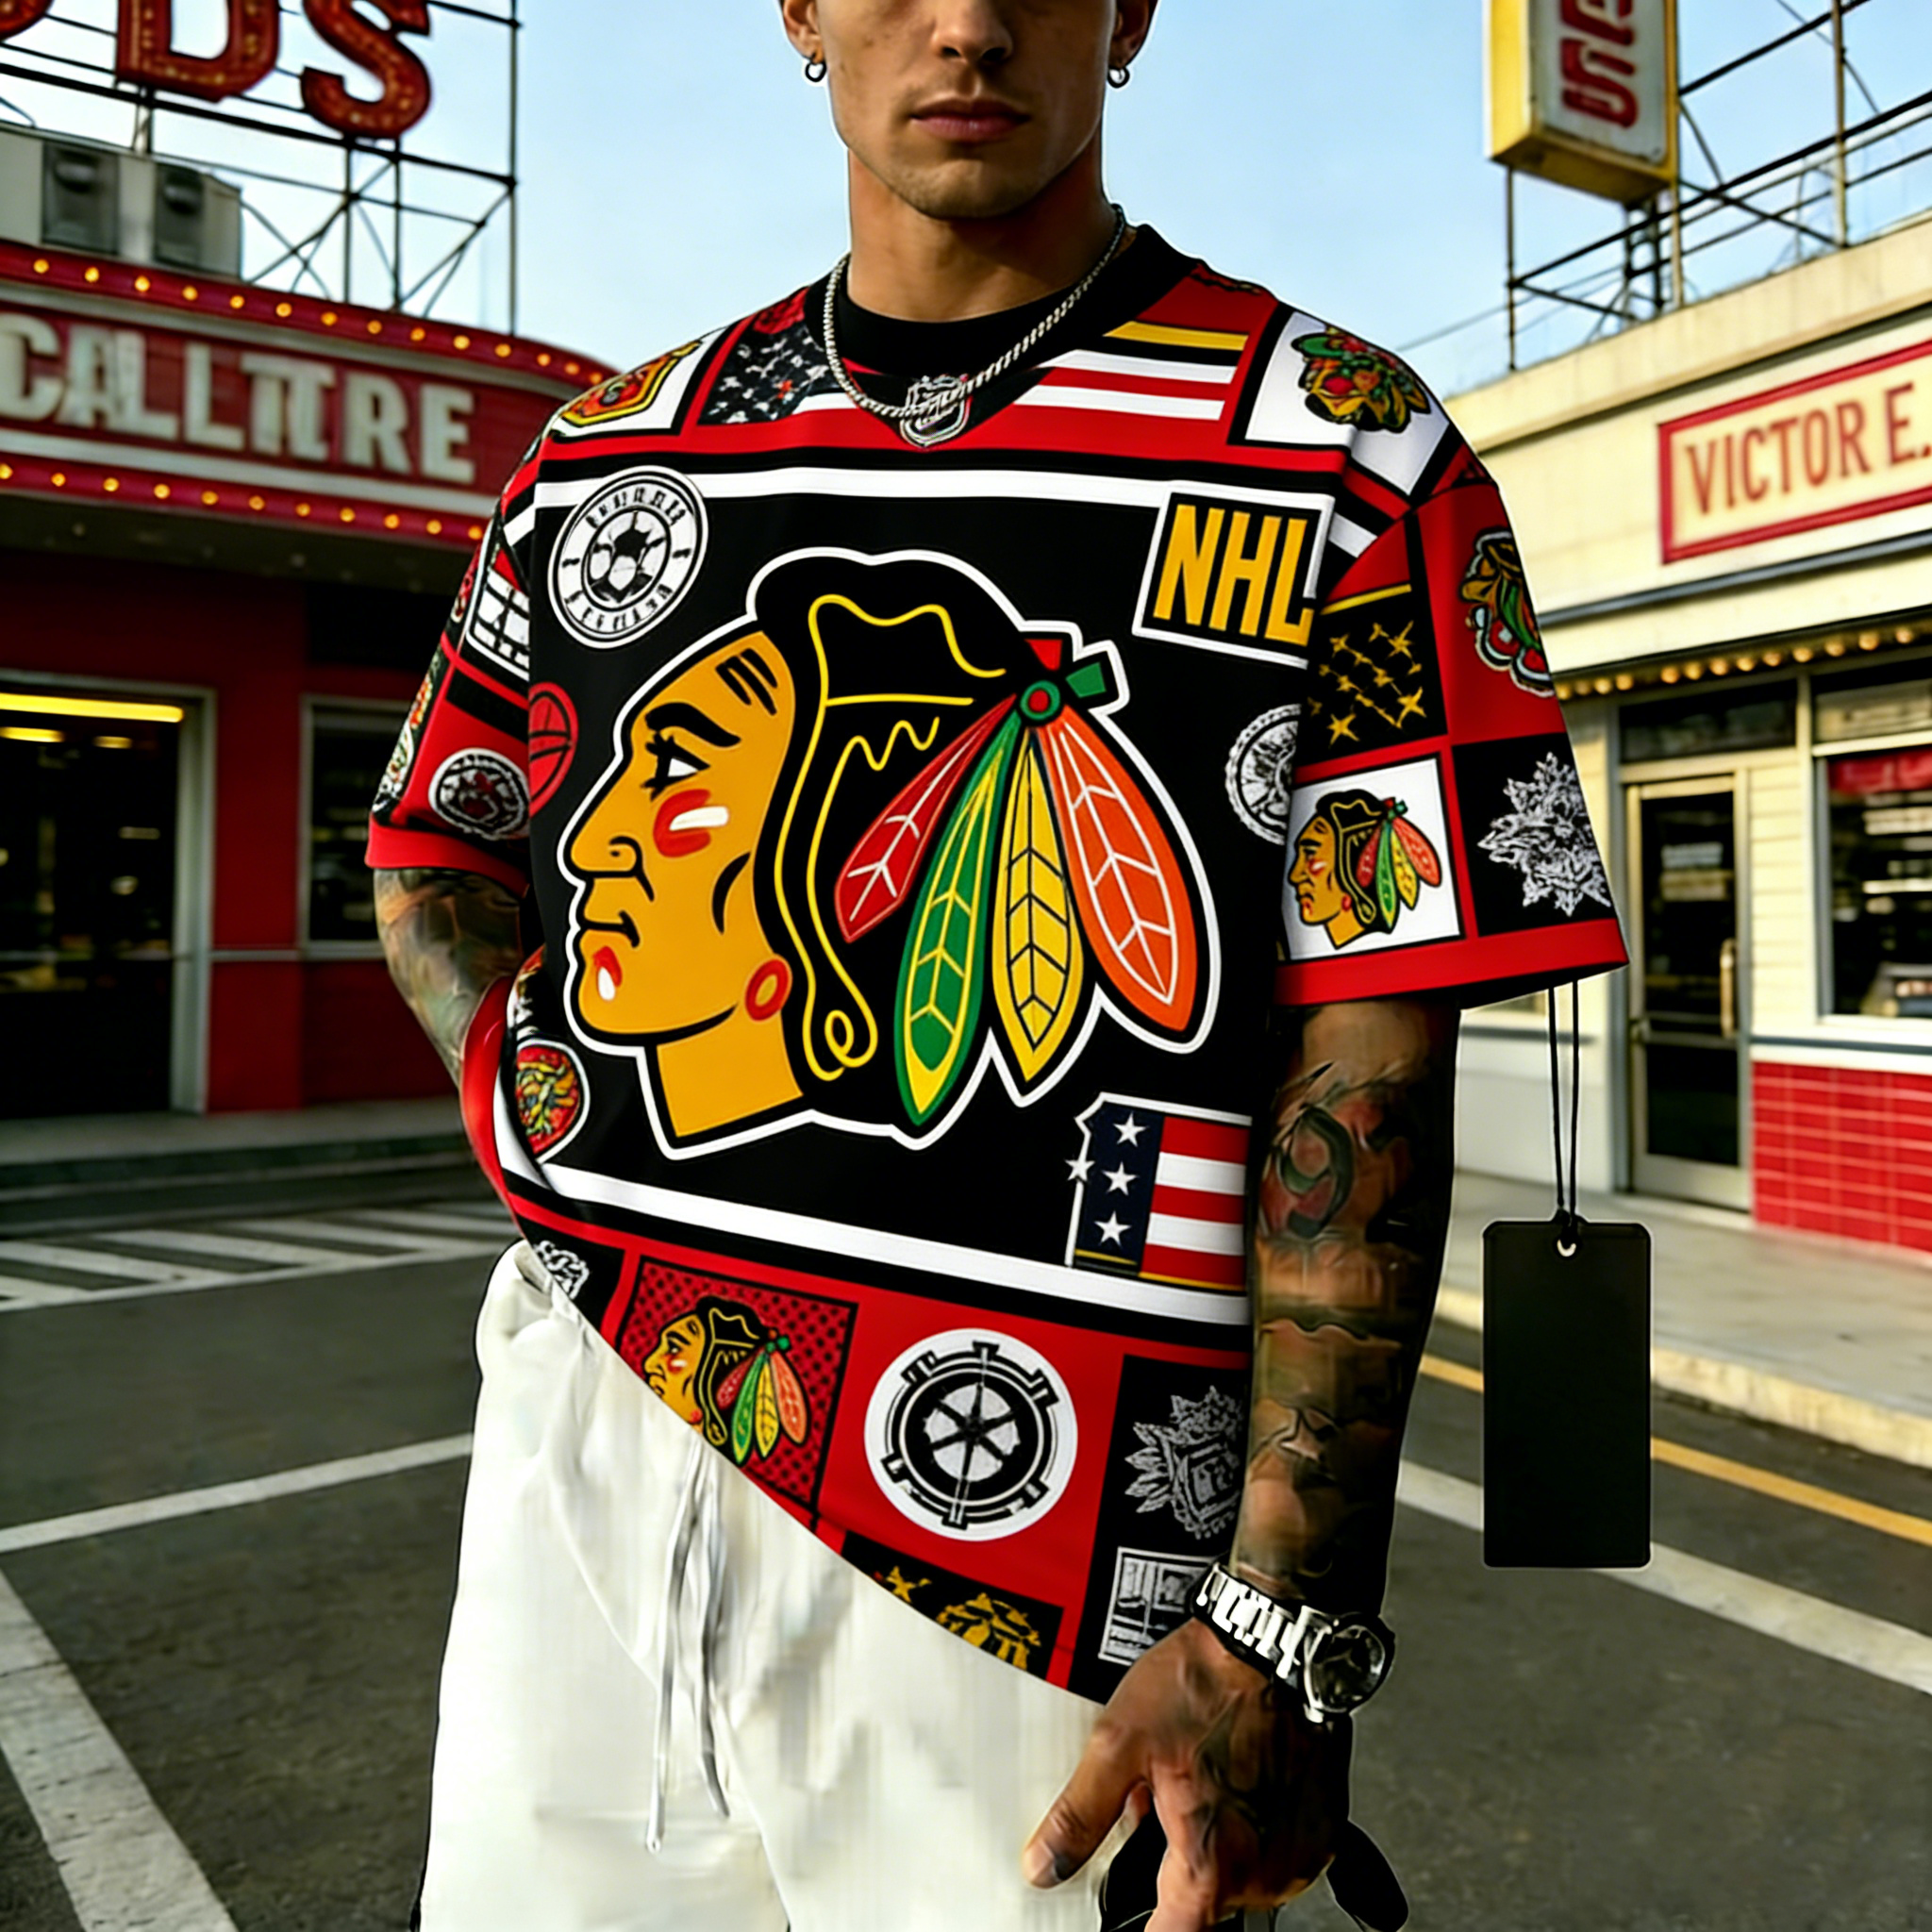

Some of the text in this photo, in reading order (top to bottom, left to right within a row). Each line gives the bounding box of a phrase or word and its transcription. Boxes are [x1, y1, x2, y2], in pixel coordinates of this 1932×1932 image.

[0, 0, 431, 139] DS
[1685, 380, 1932, 516] VICTOR E.
[1153, 504, 1314, 647] NHL
